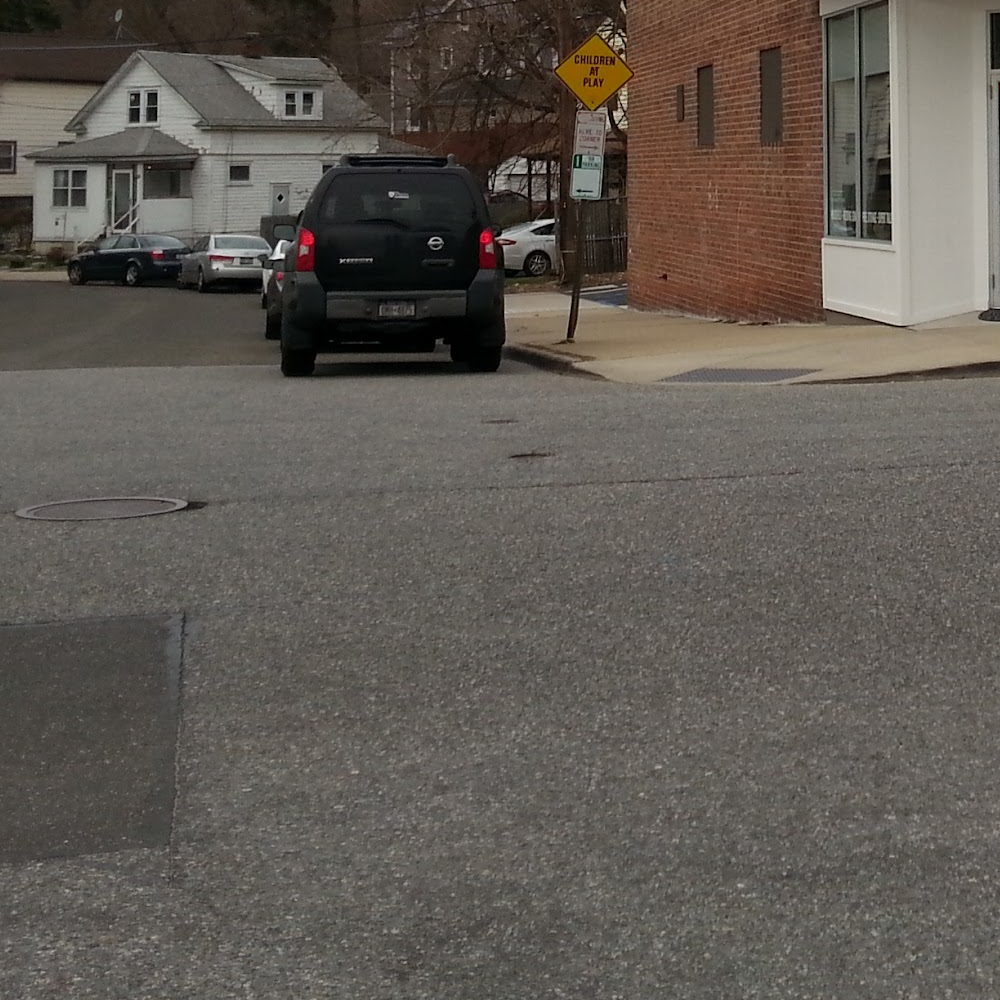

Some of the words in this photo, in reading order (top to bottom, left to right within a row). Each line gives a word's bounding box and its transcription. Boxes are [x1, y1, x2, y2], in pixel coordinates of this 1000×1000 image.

[574, 54, 616, 66] CHILDREN
[589, 66, 599, 77] AT
[582, 77, 604, 87] PLAY
